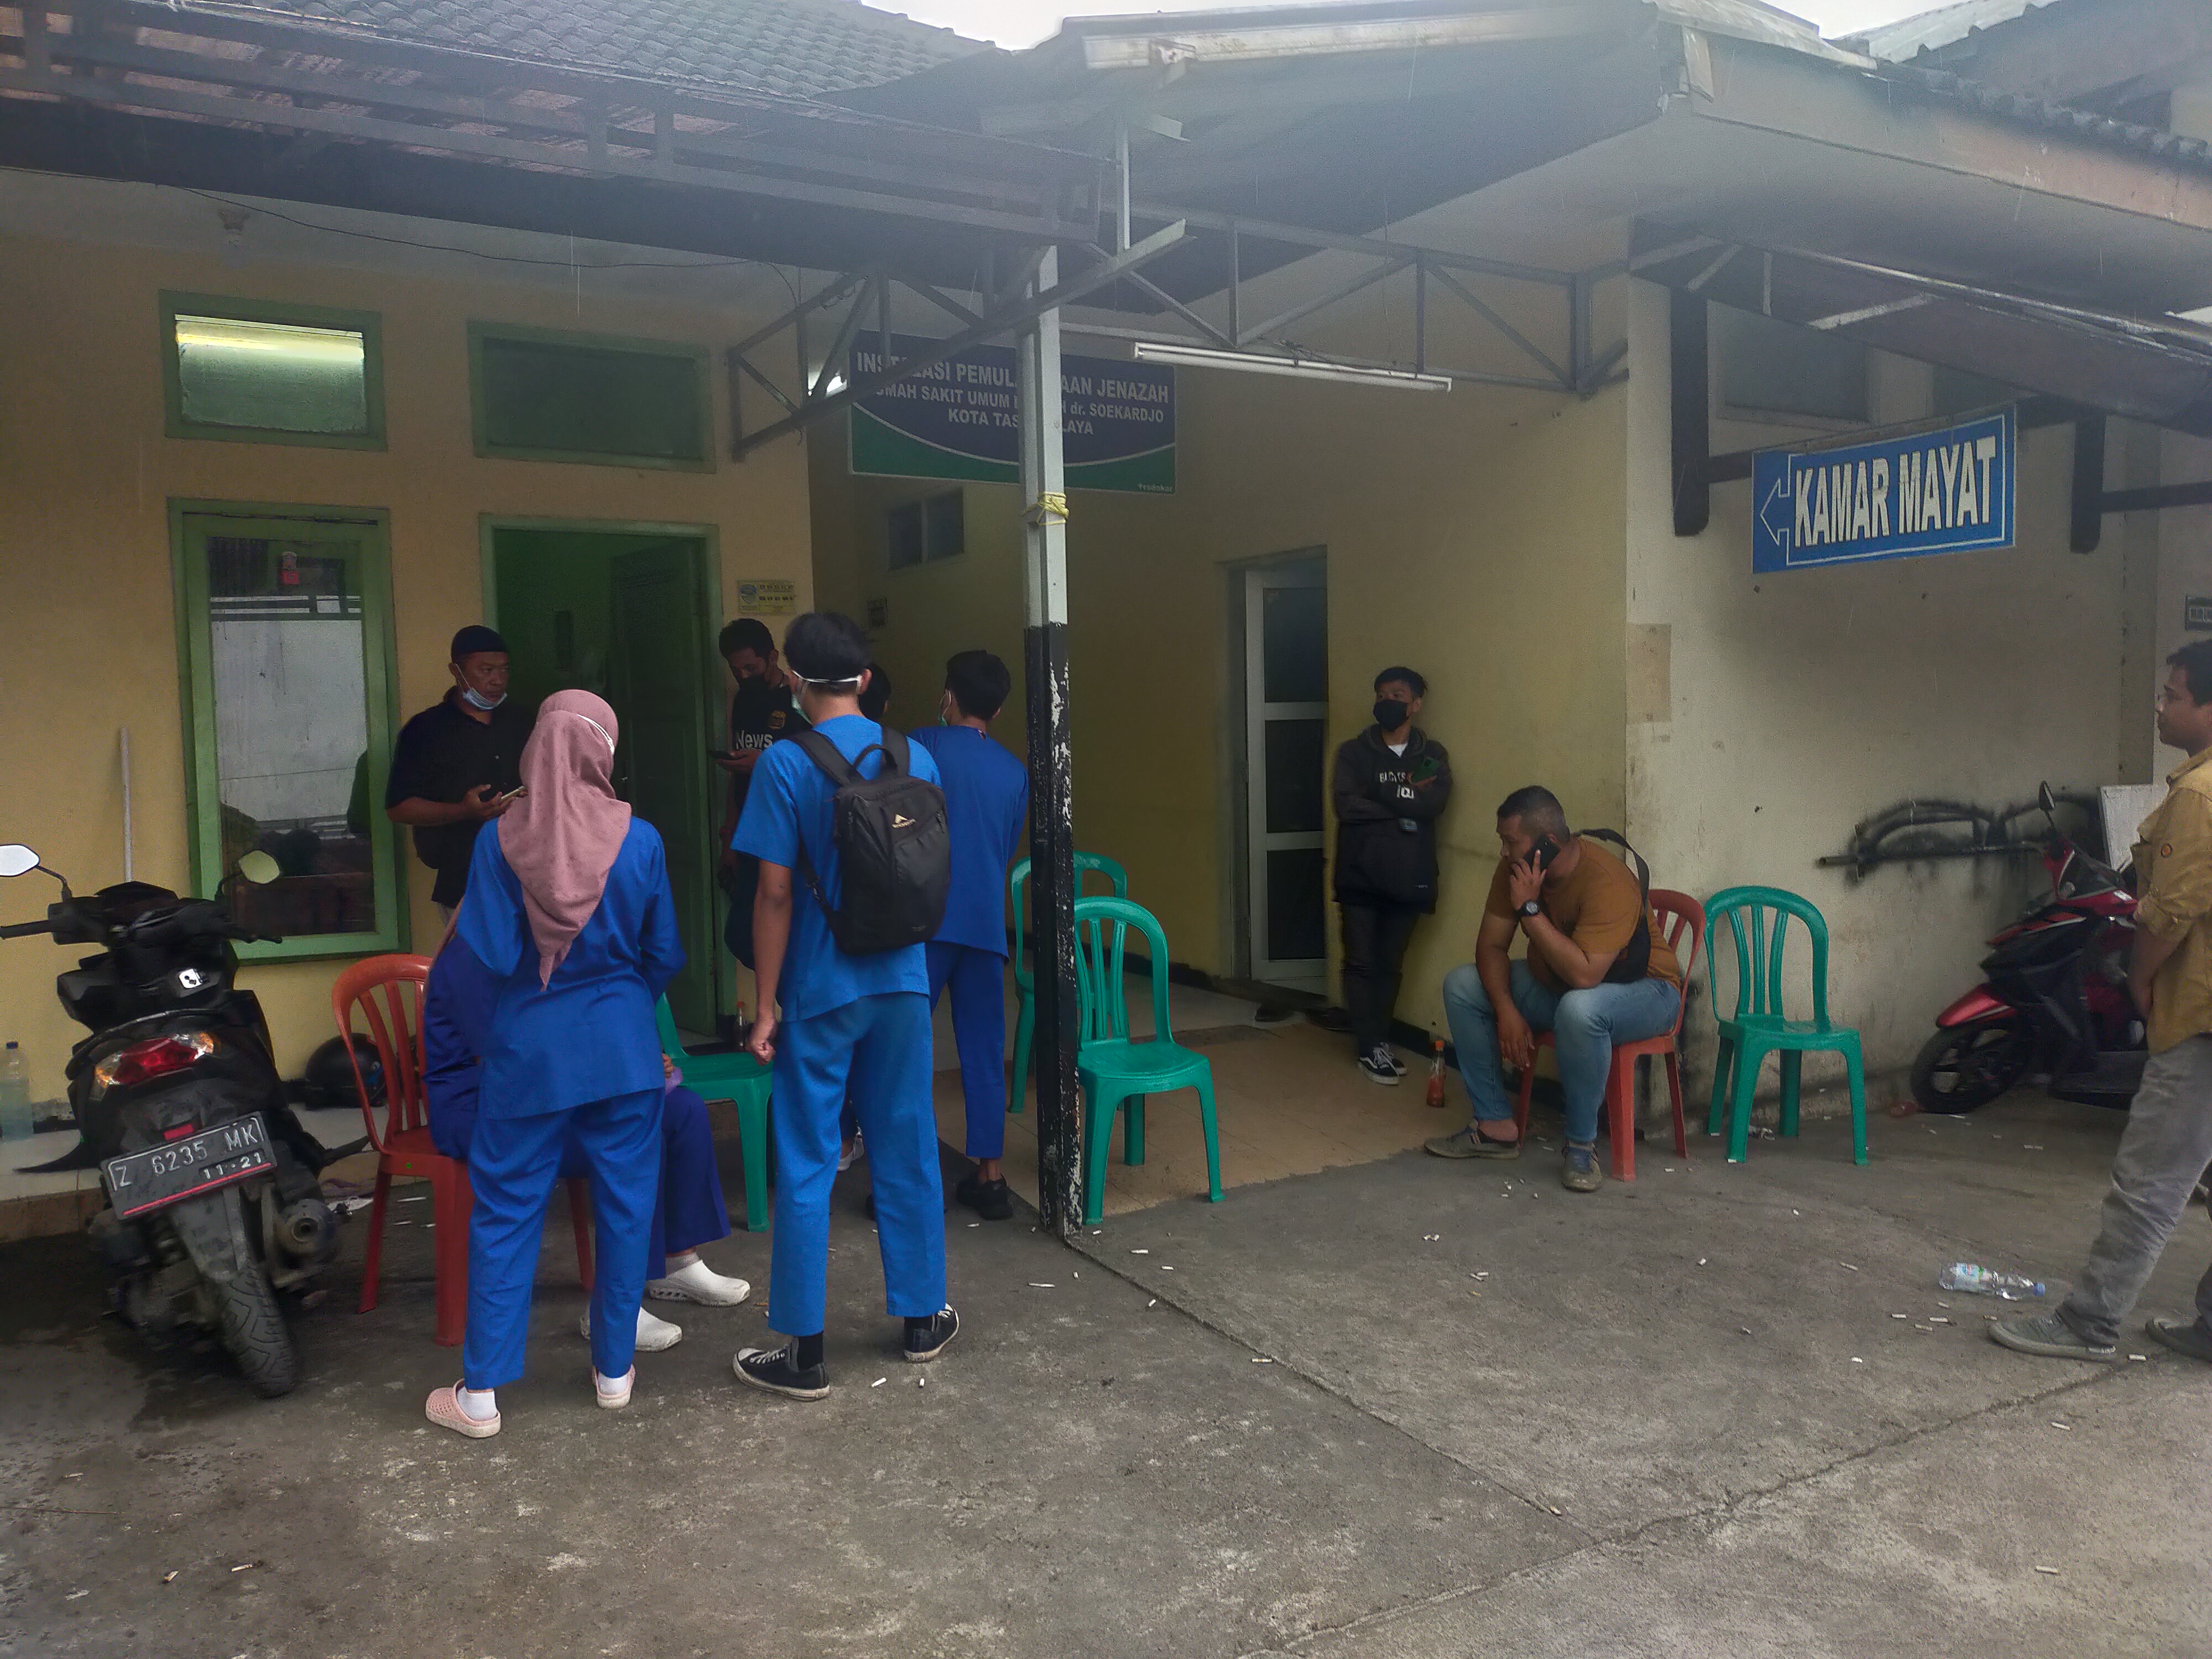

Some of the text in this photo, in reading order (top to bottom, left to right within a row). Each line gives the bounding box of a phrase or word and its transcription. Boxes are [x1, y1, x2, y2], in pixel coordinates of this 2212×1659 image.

[857, 352, 950, 380] INSTASI
[1097, 378, 1168, 404] JENAZAH
[874, 383, 917, 399] MAH
[921, 386, 963, 404] SAKIT
[968, 390, 1010, 408] UMUM
[1071, 401, 1085, 415] dr.
[1089, 403, 1164, 422] SOEKARDJO
[948, 408, 989, 426] KOTA
[1795, 436, 1996, 547] KAMAR MAYAT
[736, 730, 774, 750] News
[115, 1124, 258, 1187] Z 6235 MK
